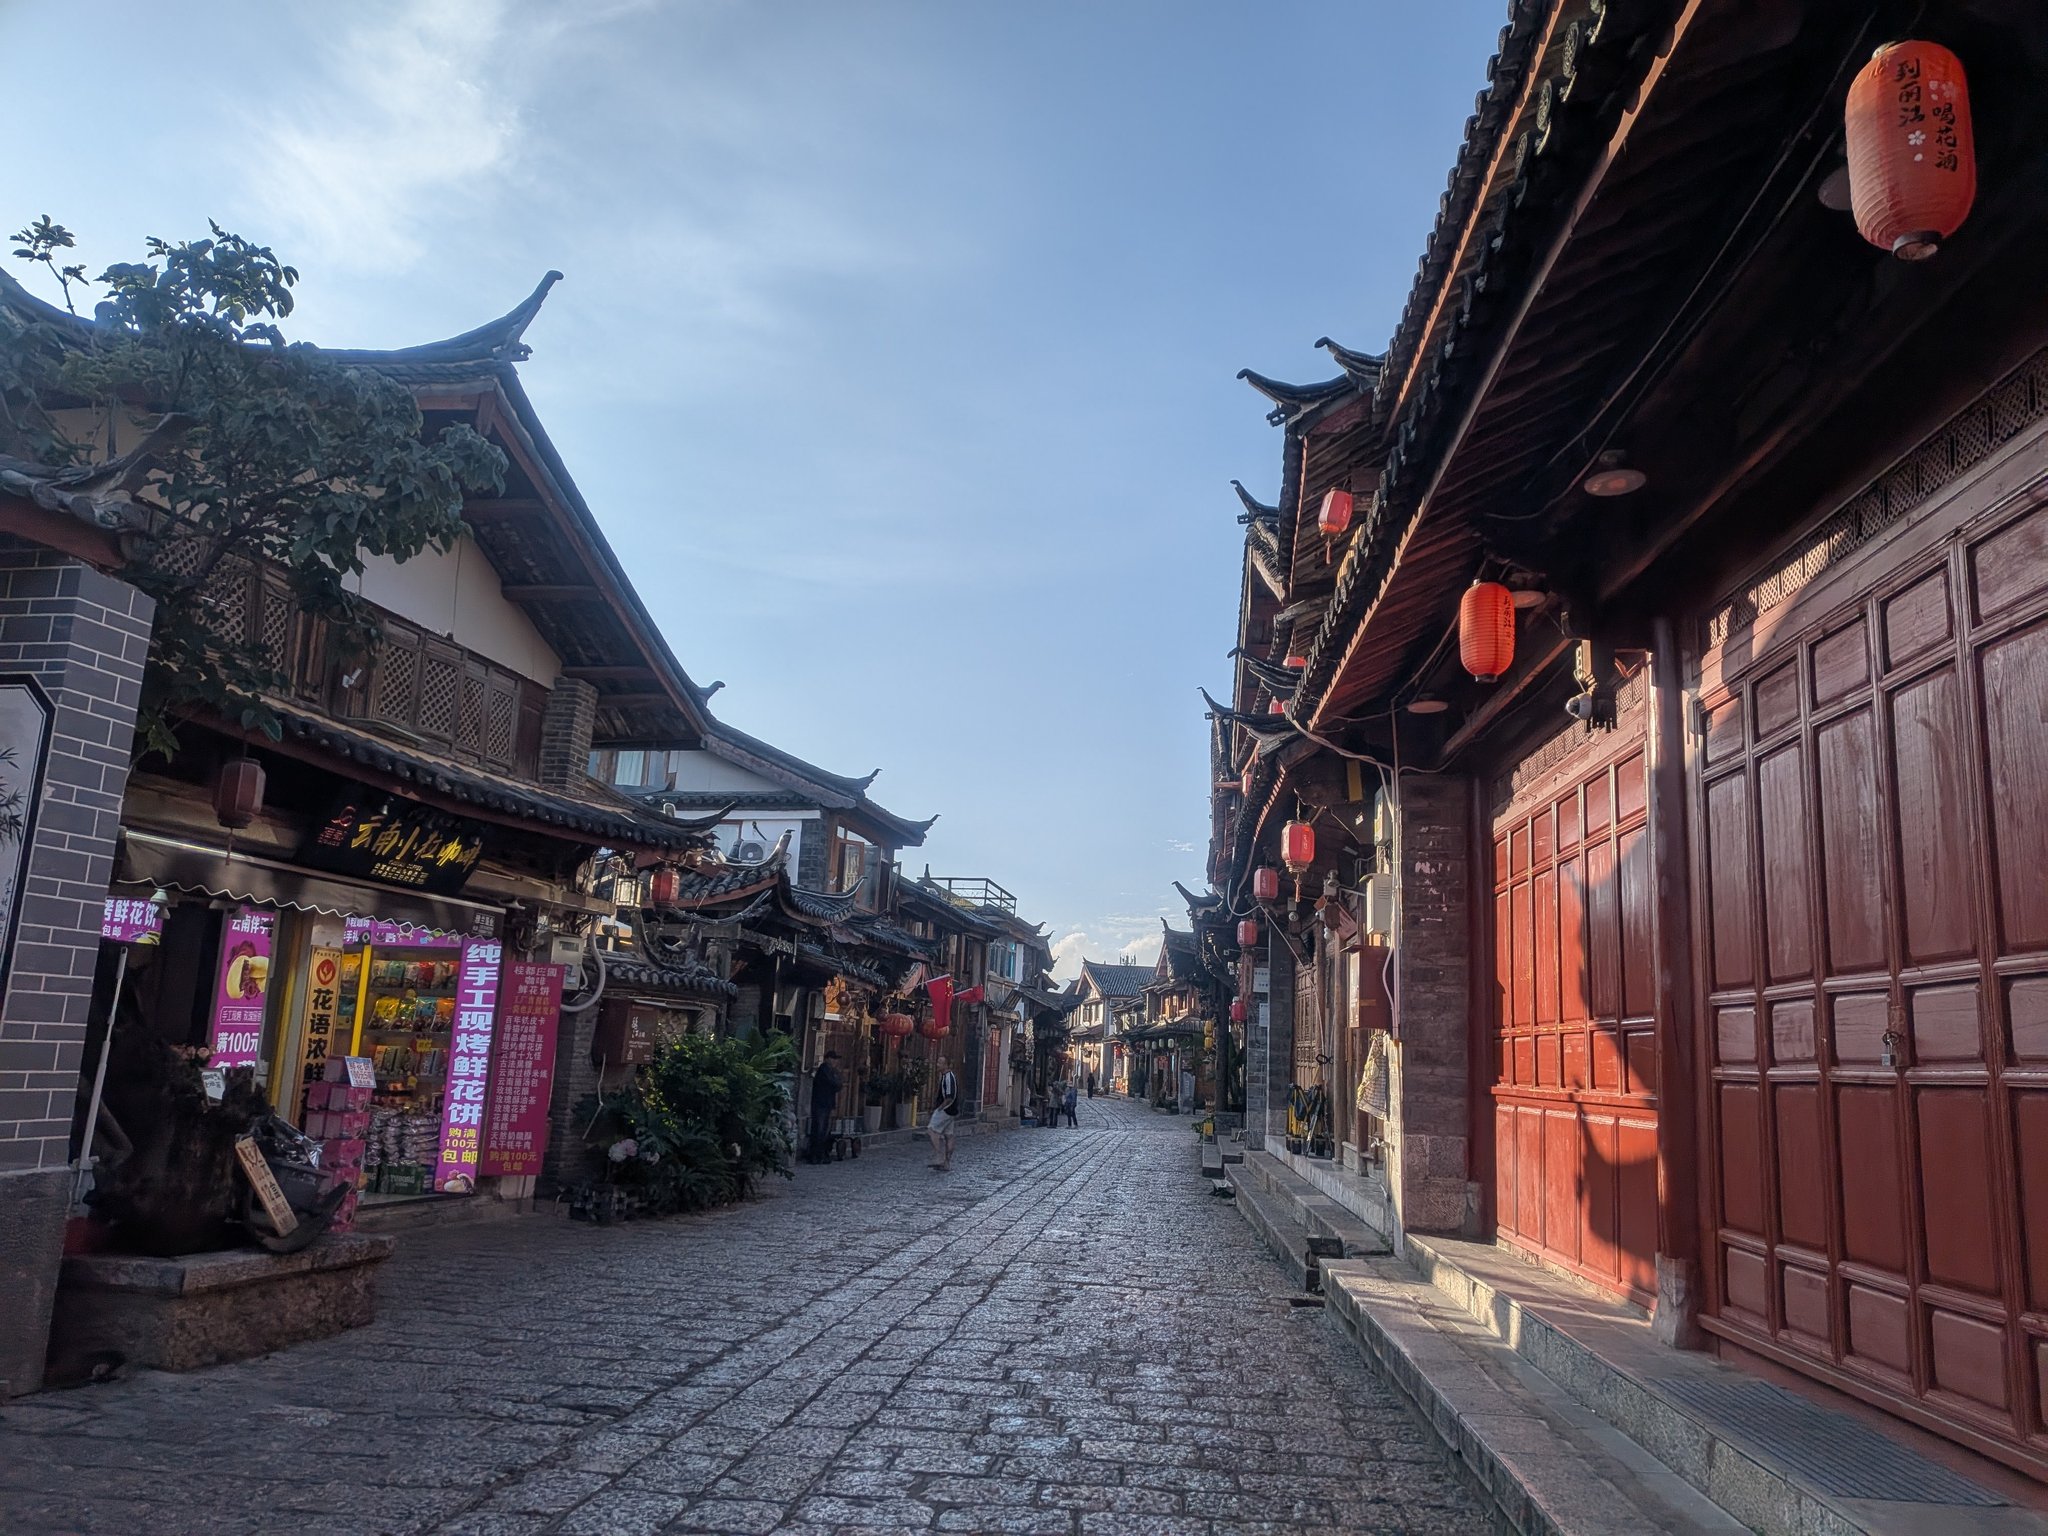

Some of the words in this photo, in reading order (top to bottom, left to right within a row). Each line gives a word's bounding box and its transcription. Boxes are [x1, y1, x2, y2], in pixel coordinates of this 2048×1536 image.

[102, 924, 123, 938] 包邮
[231, 913, 274, 935] 云南伴手
[517, 985, 550, 996] 鲜花饼
[448, 943, 502, 1125] 纯手工现烤鲜花饼
[216, 1032, 260, 1053] 满100元
[448, 1128, 477, 1139] 购满
[445, 1138, 478, 1149] 100元
[442, 1149, 478, 1165] 包邮
[502, 1161, 523, 1171] 包邮
